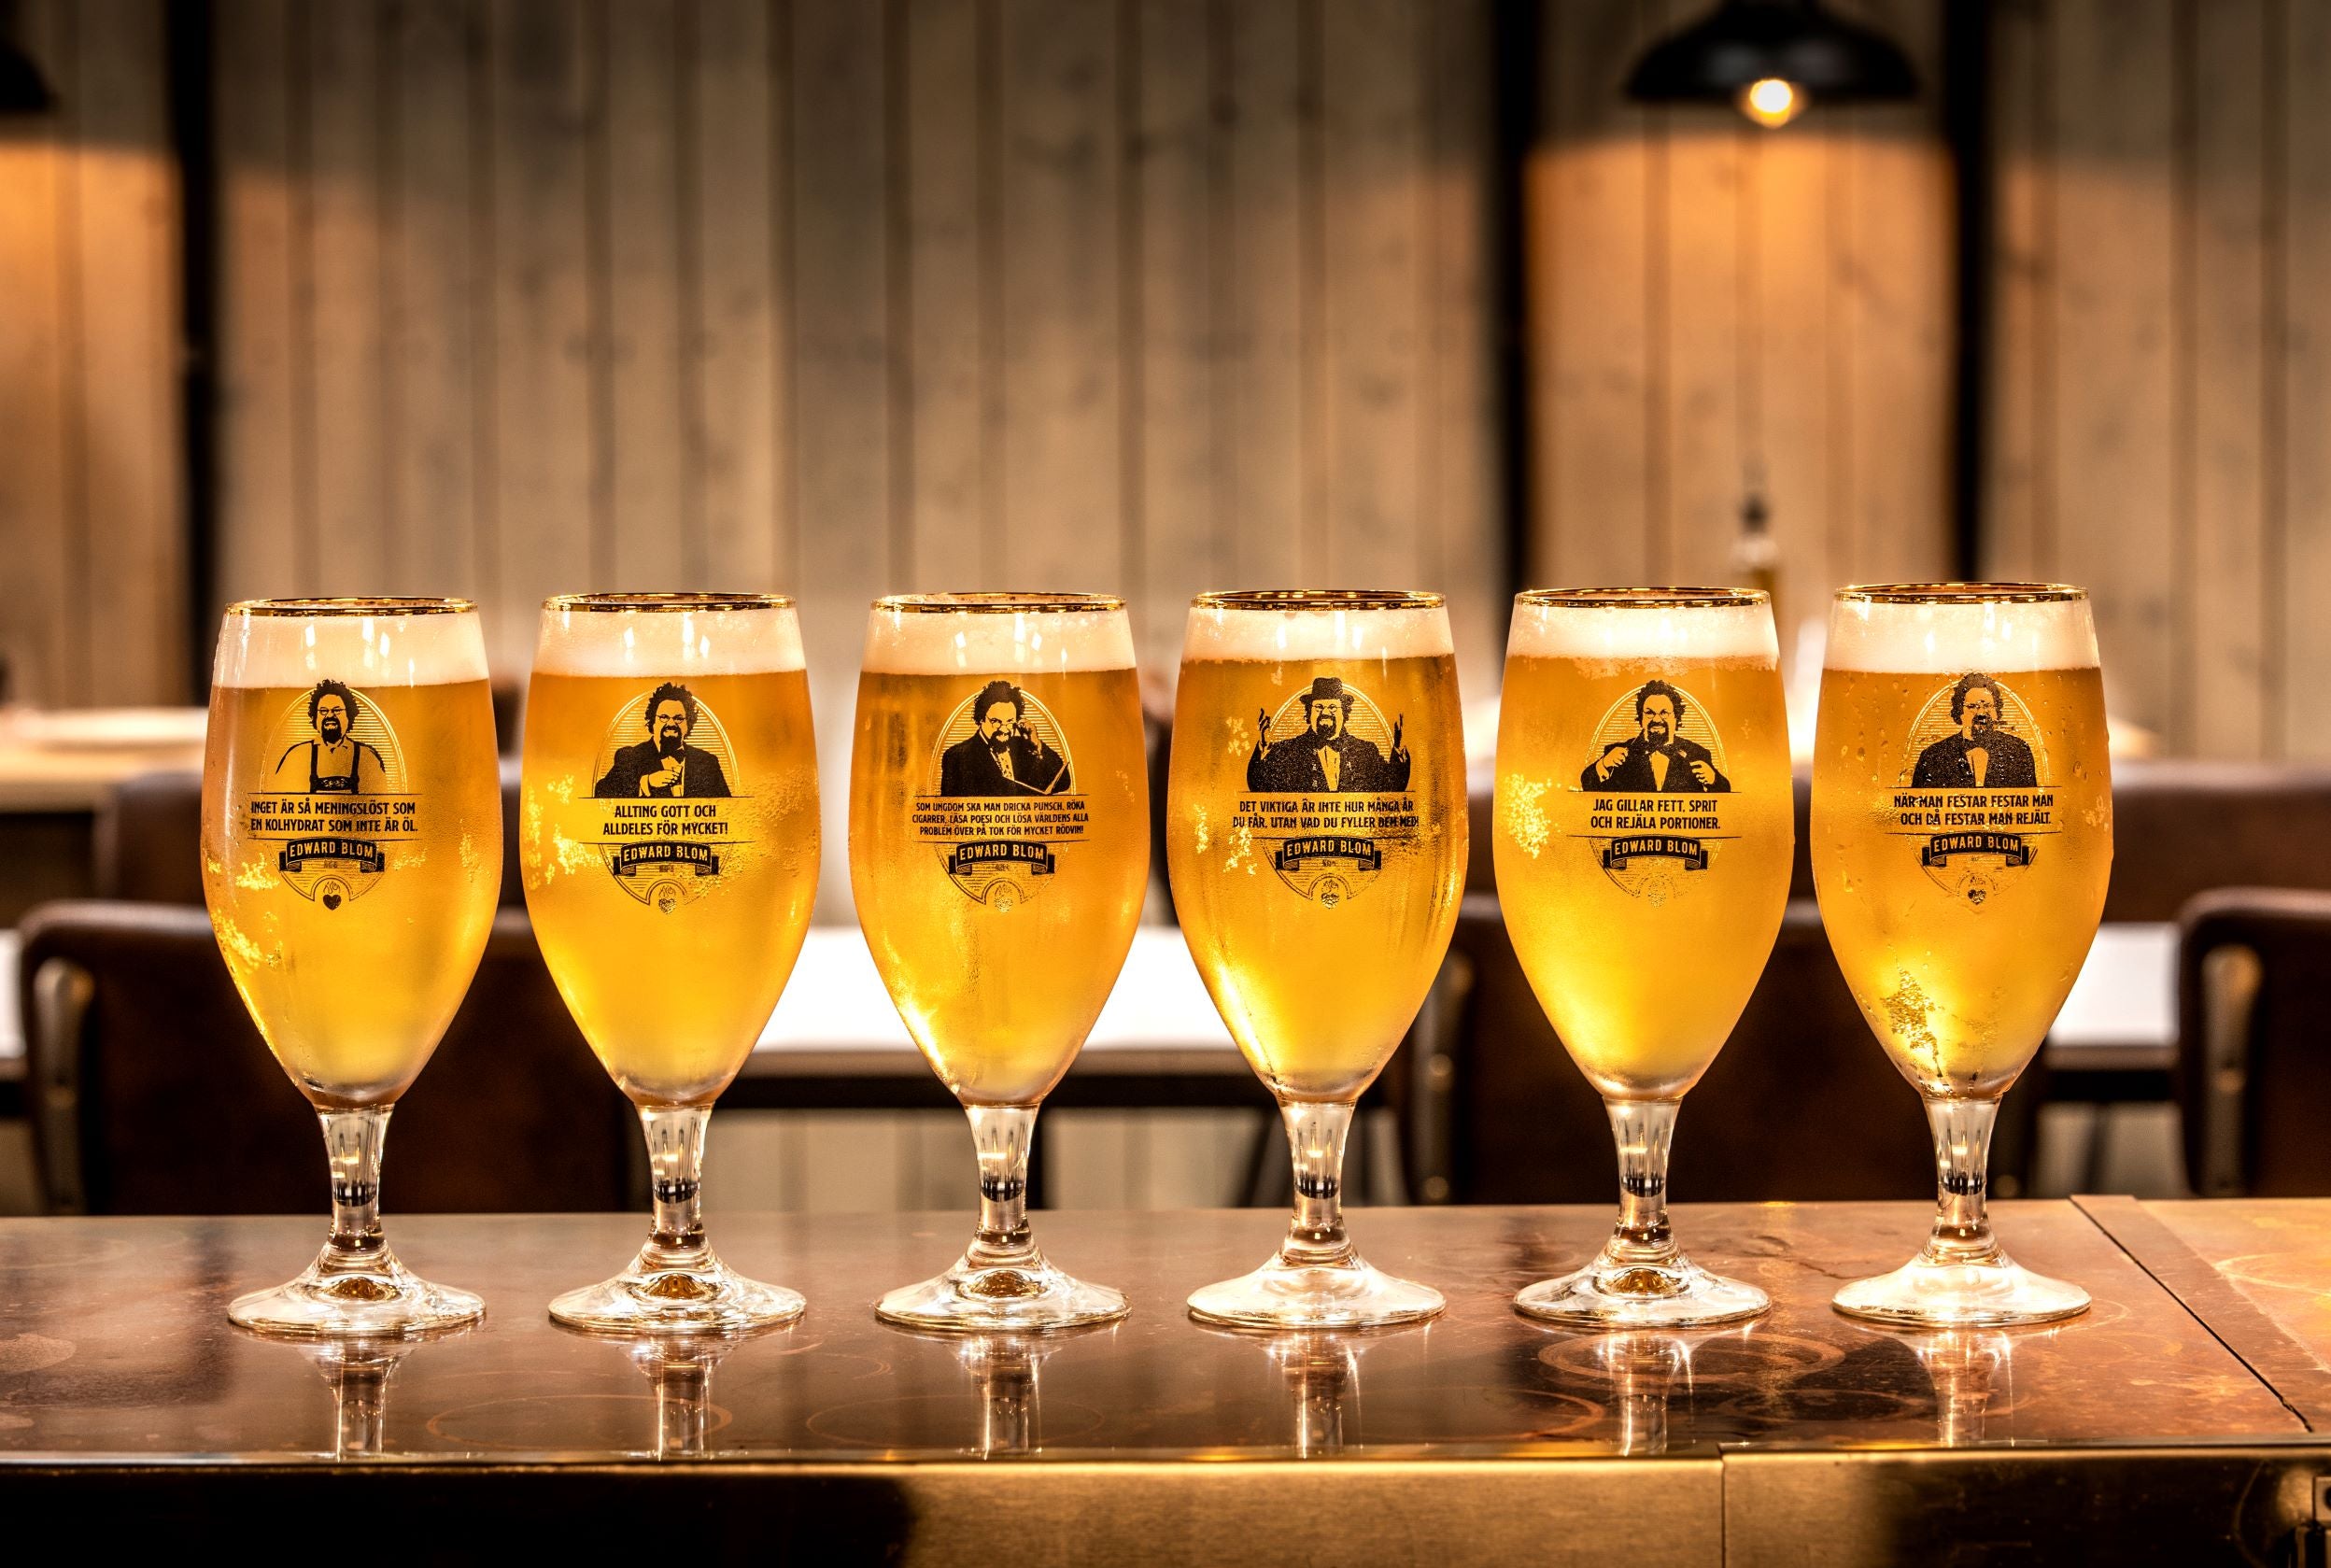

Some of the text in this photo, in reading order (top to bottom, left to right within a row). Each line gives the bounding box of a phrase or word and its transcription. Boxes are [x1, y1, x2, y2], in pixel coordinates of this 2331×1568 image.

[251, 798, 415, 814] INGET ÄR SÅ MENINGSLÖST SOM
[916, 802, 930, 811] SOM
[1004, 802, 1030, 811] DRICKA
[1067, 799, 1084, 810] RÖKA
[1240, 797, 1413, 812] DET VIKTIGA ÄR INTE HUR MÅNGA ÅR
[1593, 799, 1613, 812] JAG
[1617, 799, 1653, 812] GILLAR
[1689, 800, 1717, 812] SPRIT
[1894, 793, 2053, 807] NÄR MAN FESTAR FESTAR MAN
[615, 805, 715, 817] ALLTING GOTT OCH
[950, 812, 968, 823] LÄSA
[996, 814, 1010, 823] OCH
[1013, 812, 1032, 823] LÖSA
[1035, 812, 1070, 822] VÄRLDENS
[1073, 813, 1088, 822] ALLA
[1900, 812, 1922, 825] OCH
[1945, 812, 1985, 825] FESTAR
[1989, 812, 2013, 825] MAN
[2016, 810, 2051, 824] REJÄLT.
[250, 817, 418, 831] EN KOLHYDRAT SOM INTE ÄR ÖL.
[603, 820, 728, 835] ALLDELES FÖR MYCKET!
[1233, 817, 1244, 826] DU
[1271, 817, 1296, 827] UTAN
[1301, 817, 1320, 827] VAD
[1323, 817, 1337, 827] DU
[1341, 817, 1375, 827] FYLLER
[1591, 813, 1720, 829] OCH REJÄLA PORTIONER.
[920, 826, 952, 835] PROBLEM
[954, 824, 973, 835] ÖVER
[977, 824, 986, 835] PÅ
[989, 826, 1004, 835] TOK
[1007, 825, 1021, 835] FÖR
[1024, 826, 1053, 834] MYCKET
[290, 841, 373, 857] EDWARD BLOM
[1287, 841, 1371, 856] EDWARD BLOM
[1615, 840, 1698, 855] EDWARD BLOM
[1934, 836, 2018, 852] EDWARD BLOM
[624, 845, 708, 861] EDWARD BLOM
[960, 844, 1044, 860] EDWARD BLOM
